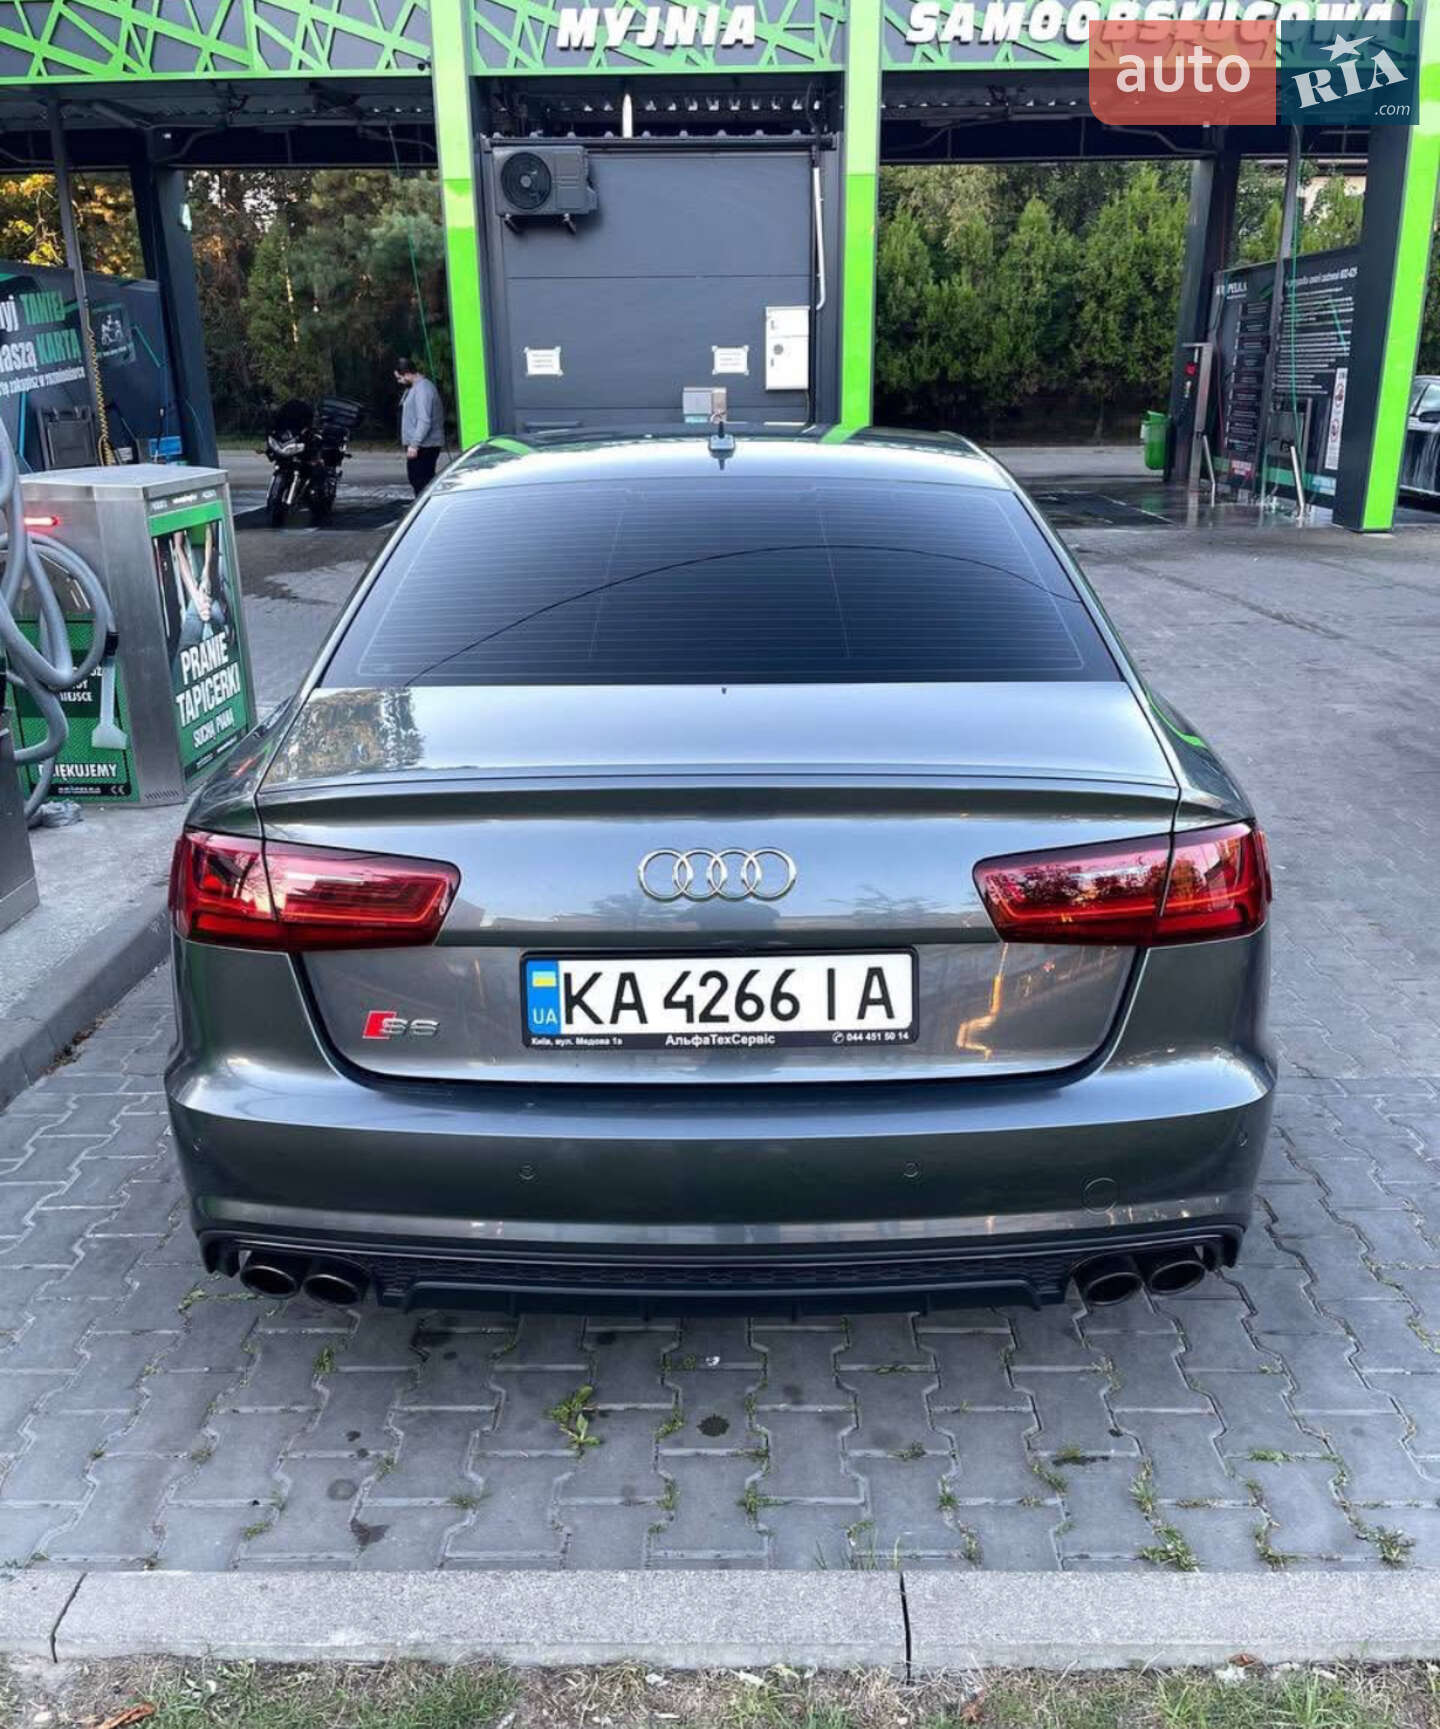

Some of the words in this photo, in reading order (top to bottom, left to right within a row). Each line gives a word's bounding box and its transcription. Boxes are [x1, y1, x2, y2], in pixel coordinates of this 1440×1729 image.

[556, 6, 755, 49] MYJNIA
[180, 631, 229, 685] PRANIE
[176, 662, 241, 727] TAPICERKI
[533, 1007, 557, 1025] UA
[564, 971, 648, 1024] KA
[663, 969, 800, 1024] 4266
[665, 1033, 775, 1048] АльфаТехСервіс
